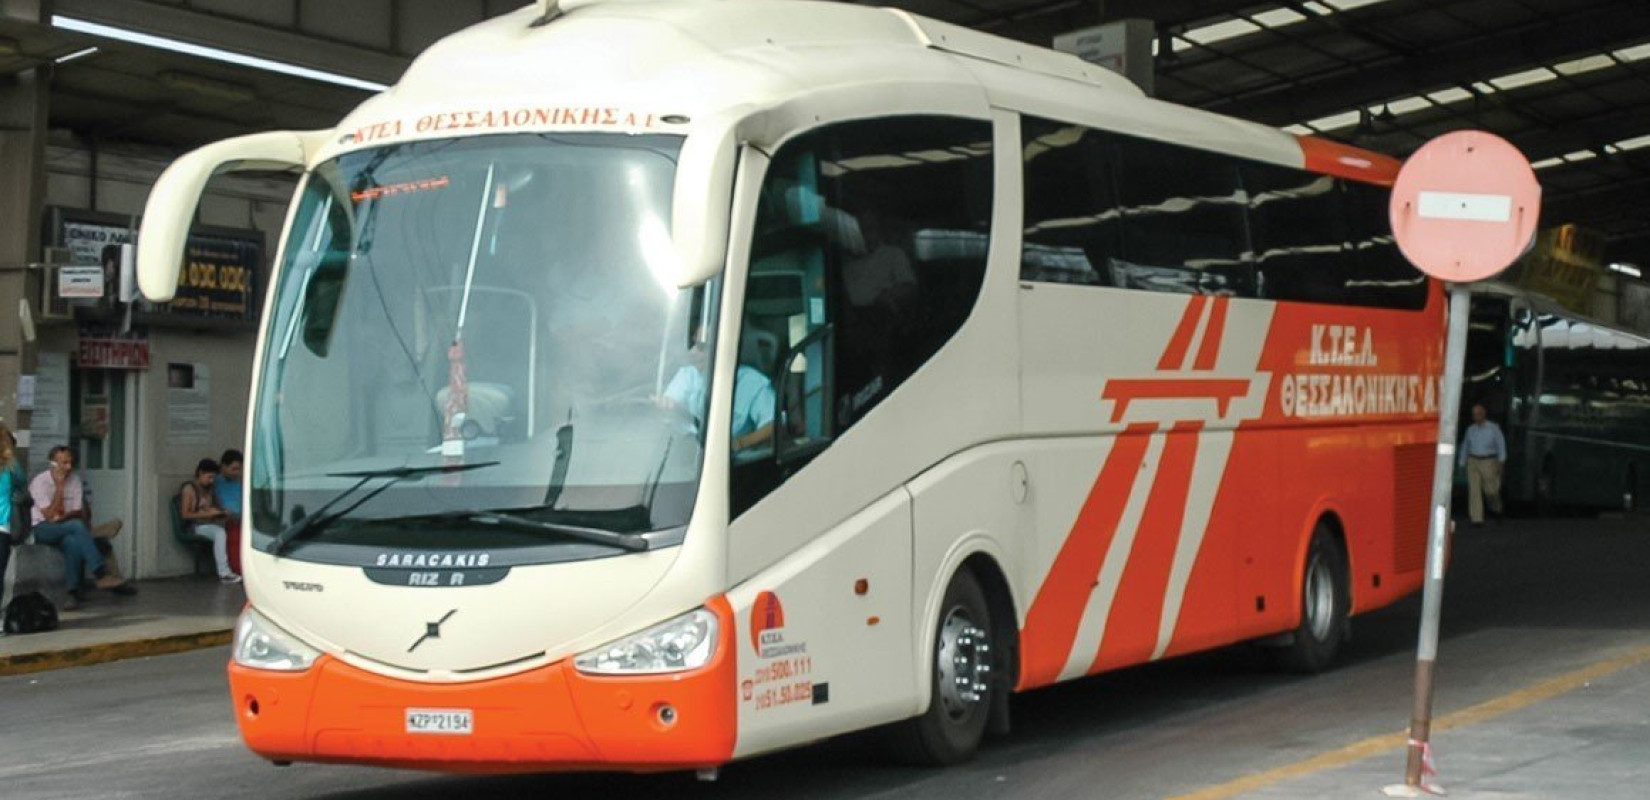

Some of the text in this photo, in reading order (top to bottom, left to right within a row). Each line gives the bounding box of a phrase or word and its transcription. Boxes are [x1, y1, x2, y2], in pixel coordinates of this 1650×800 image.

[416, 107, 619, 133] ΘΕΣΣΑΛΟΝΙΚΗΣ
[1281, 373, 1419, 417] ΘΕΣΣΑΛΟΝΙΚΗΣ
[376, 554, 490, 566] SARACAKIS
